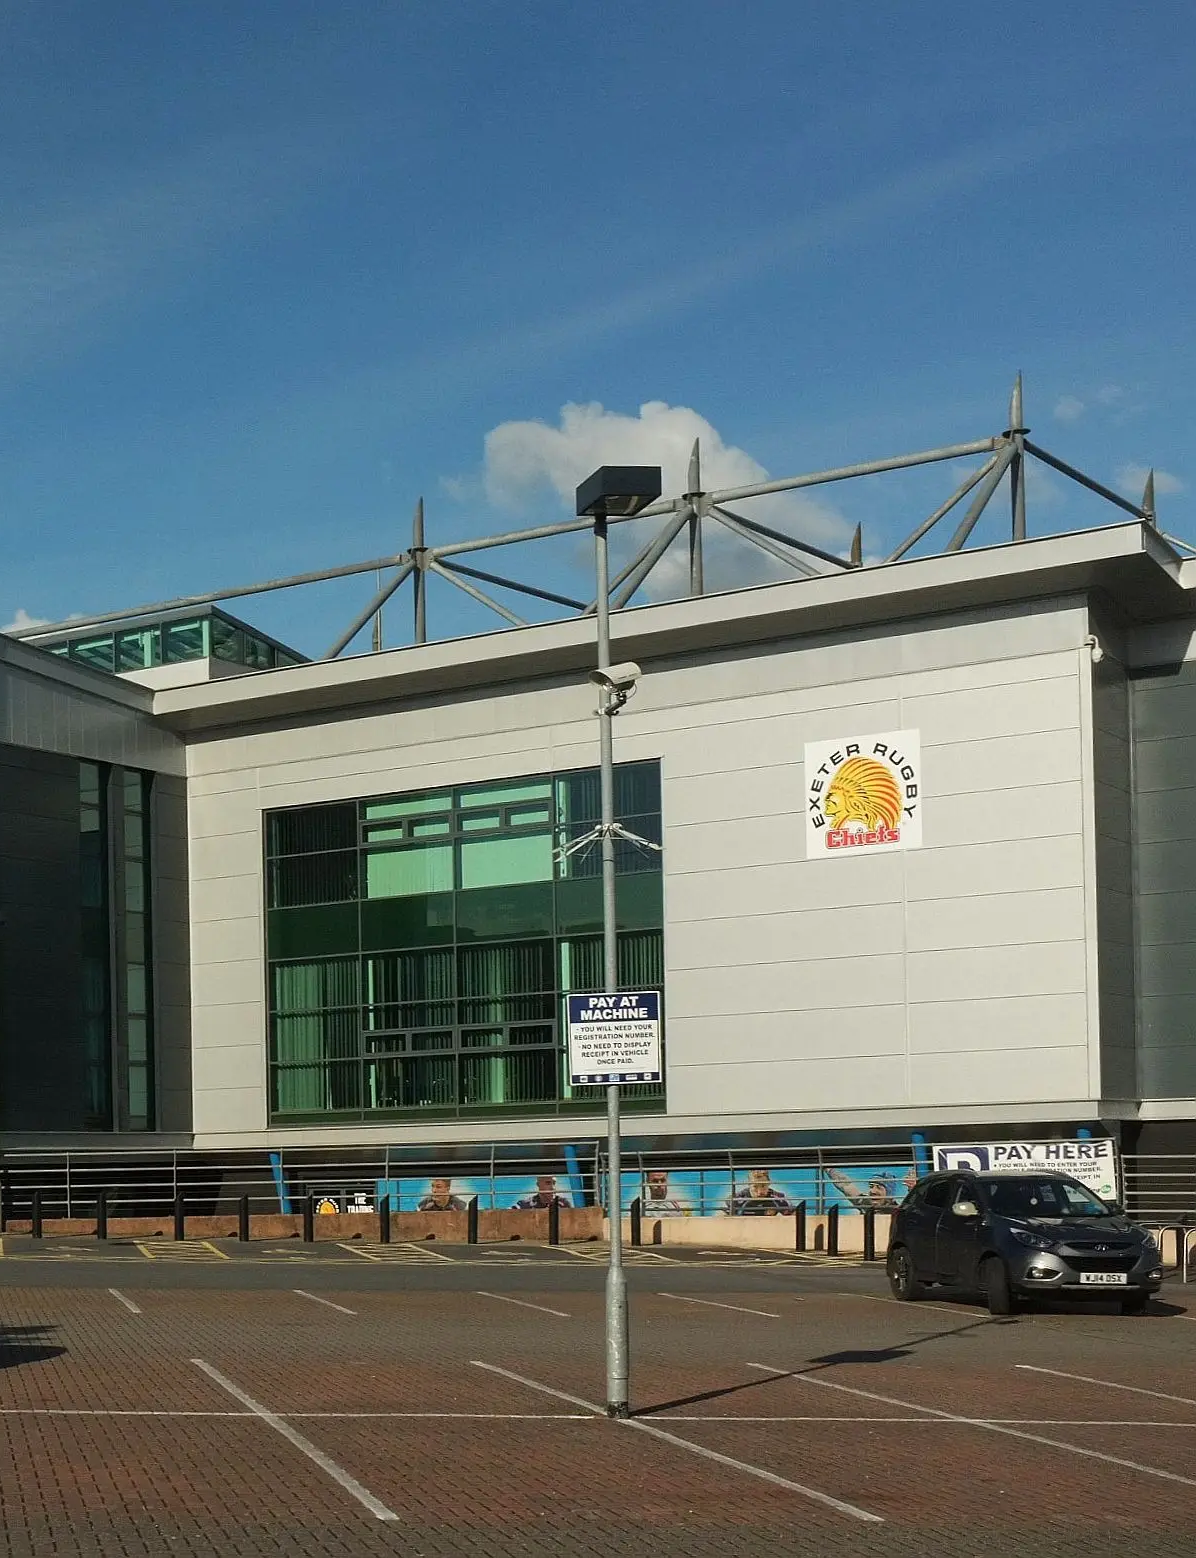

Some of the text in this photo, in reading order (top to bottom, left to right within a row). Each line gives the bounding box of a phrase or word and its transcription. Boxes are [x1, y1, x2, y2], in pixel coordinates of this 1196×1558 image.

[809, 742, 918, 829] EXETER RUGBY
[825, 826, 900, 849] Chiefs
[588, 995, 639, 1009] PAY AT
[580, 1007, 648, 1021] MACHINE
[574, 1033, 623, 1041] REGISTRATION
[994, 1144, 1108, 1161] PAY HERE
